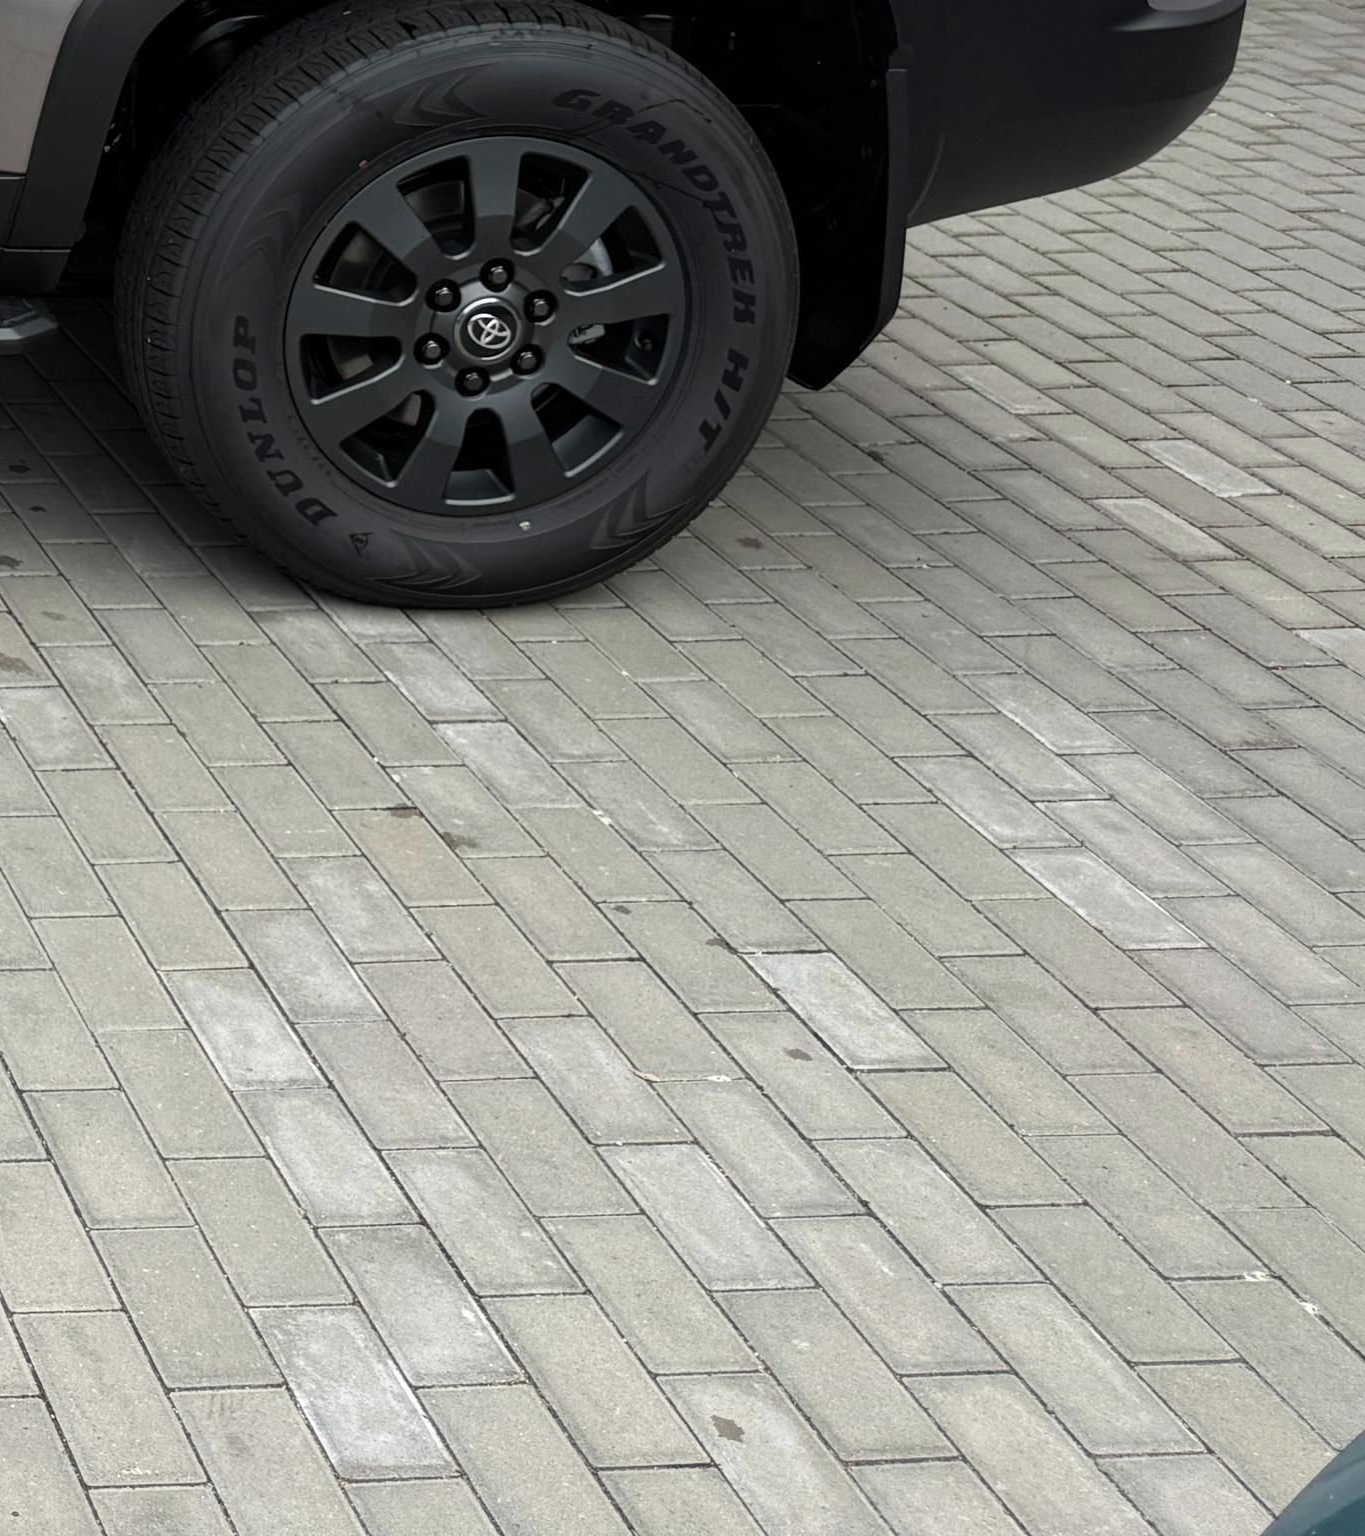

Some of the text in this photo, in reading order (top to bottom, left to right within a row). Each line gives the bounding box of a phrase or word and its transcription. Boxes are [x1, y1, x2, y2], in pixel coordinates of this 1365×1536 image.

[552, 88, 757, 454] GRANDTREK H/T
[232, 315, 338, 526] DUNLOP
